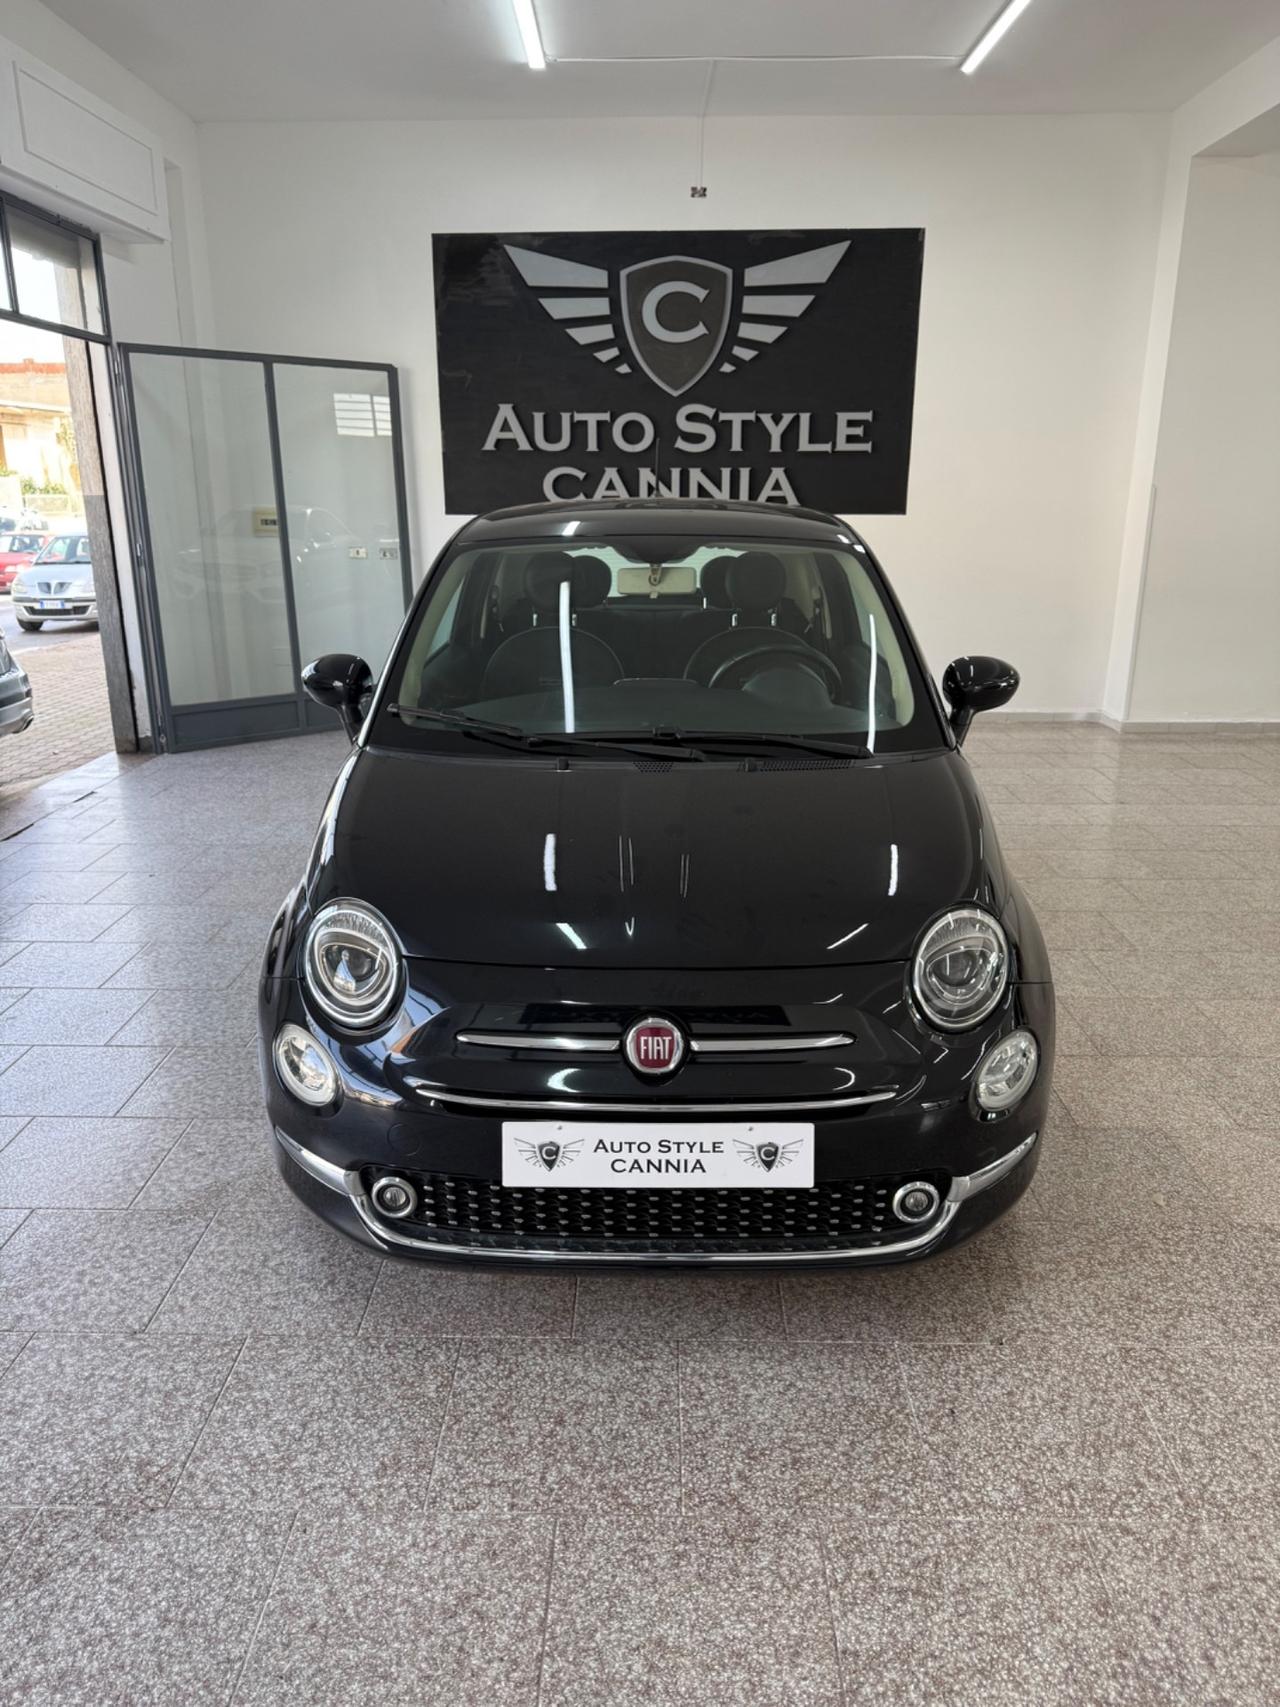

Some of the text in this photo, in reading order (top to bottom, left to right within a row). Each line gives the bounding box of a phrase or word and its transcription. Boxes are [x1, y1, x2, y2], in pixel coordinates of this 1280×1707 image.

[642, 281, 709, 343] C
[482, 403, 873, 453] AUTO STYLE
[543, 466, 799, 503] CANNIA
[640, 1036, 672, 1060] FIAT
[542, 1146, 557, 1160] C
[593, 1139, 724, 1153] AUTO STYLE
[761, 1147, 776, 1160] C
[610, 1158, 706, 1173] CANNIA
